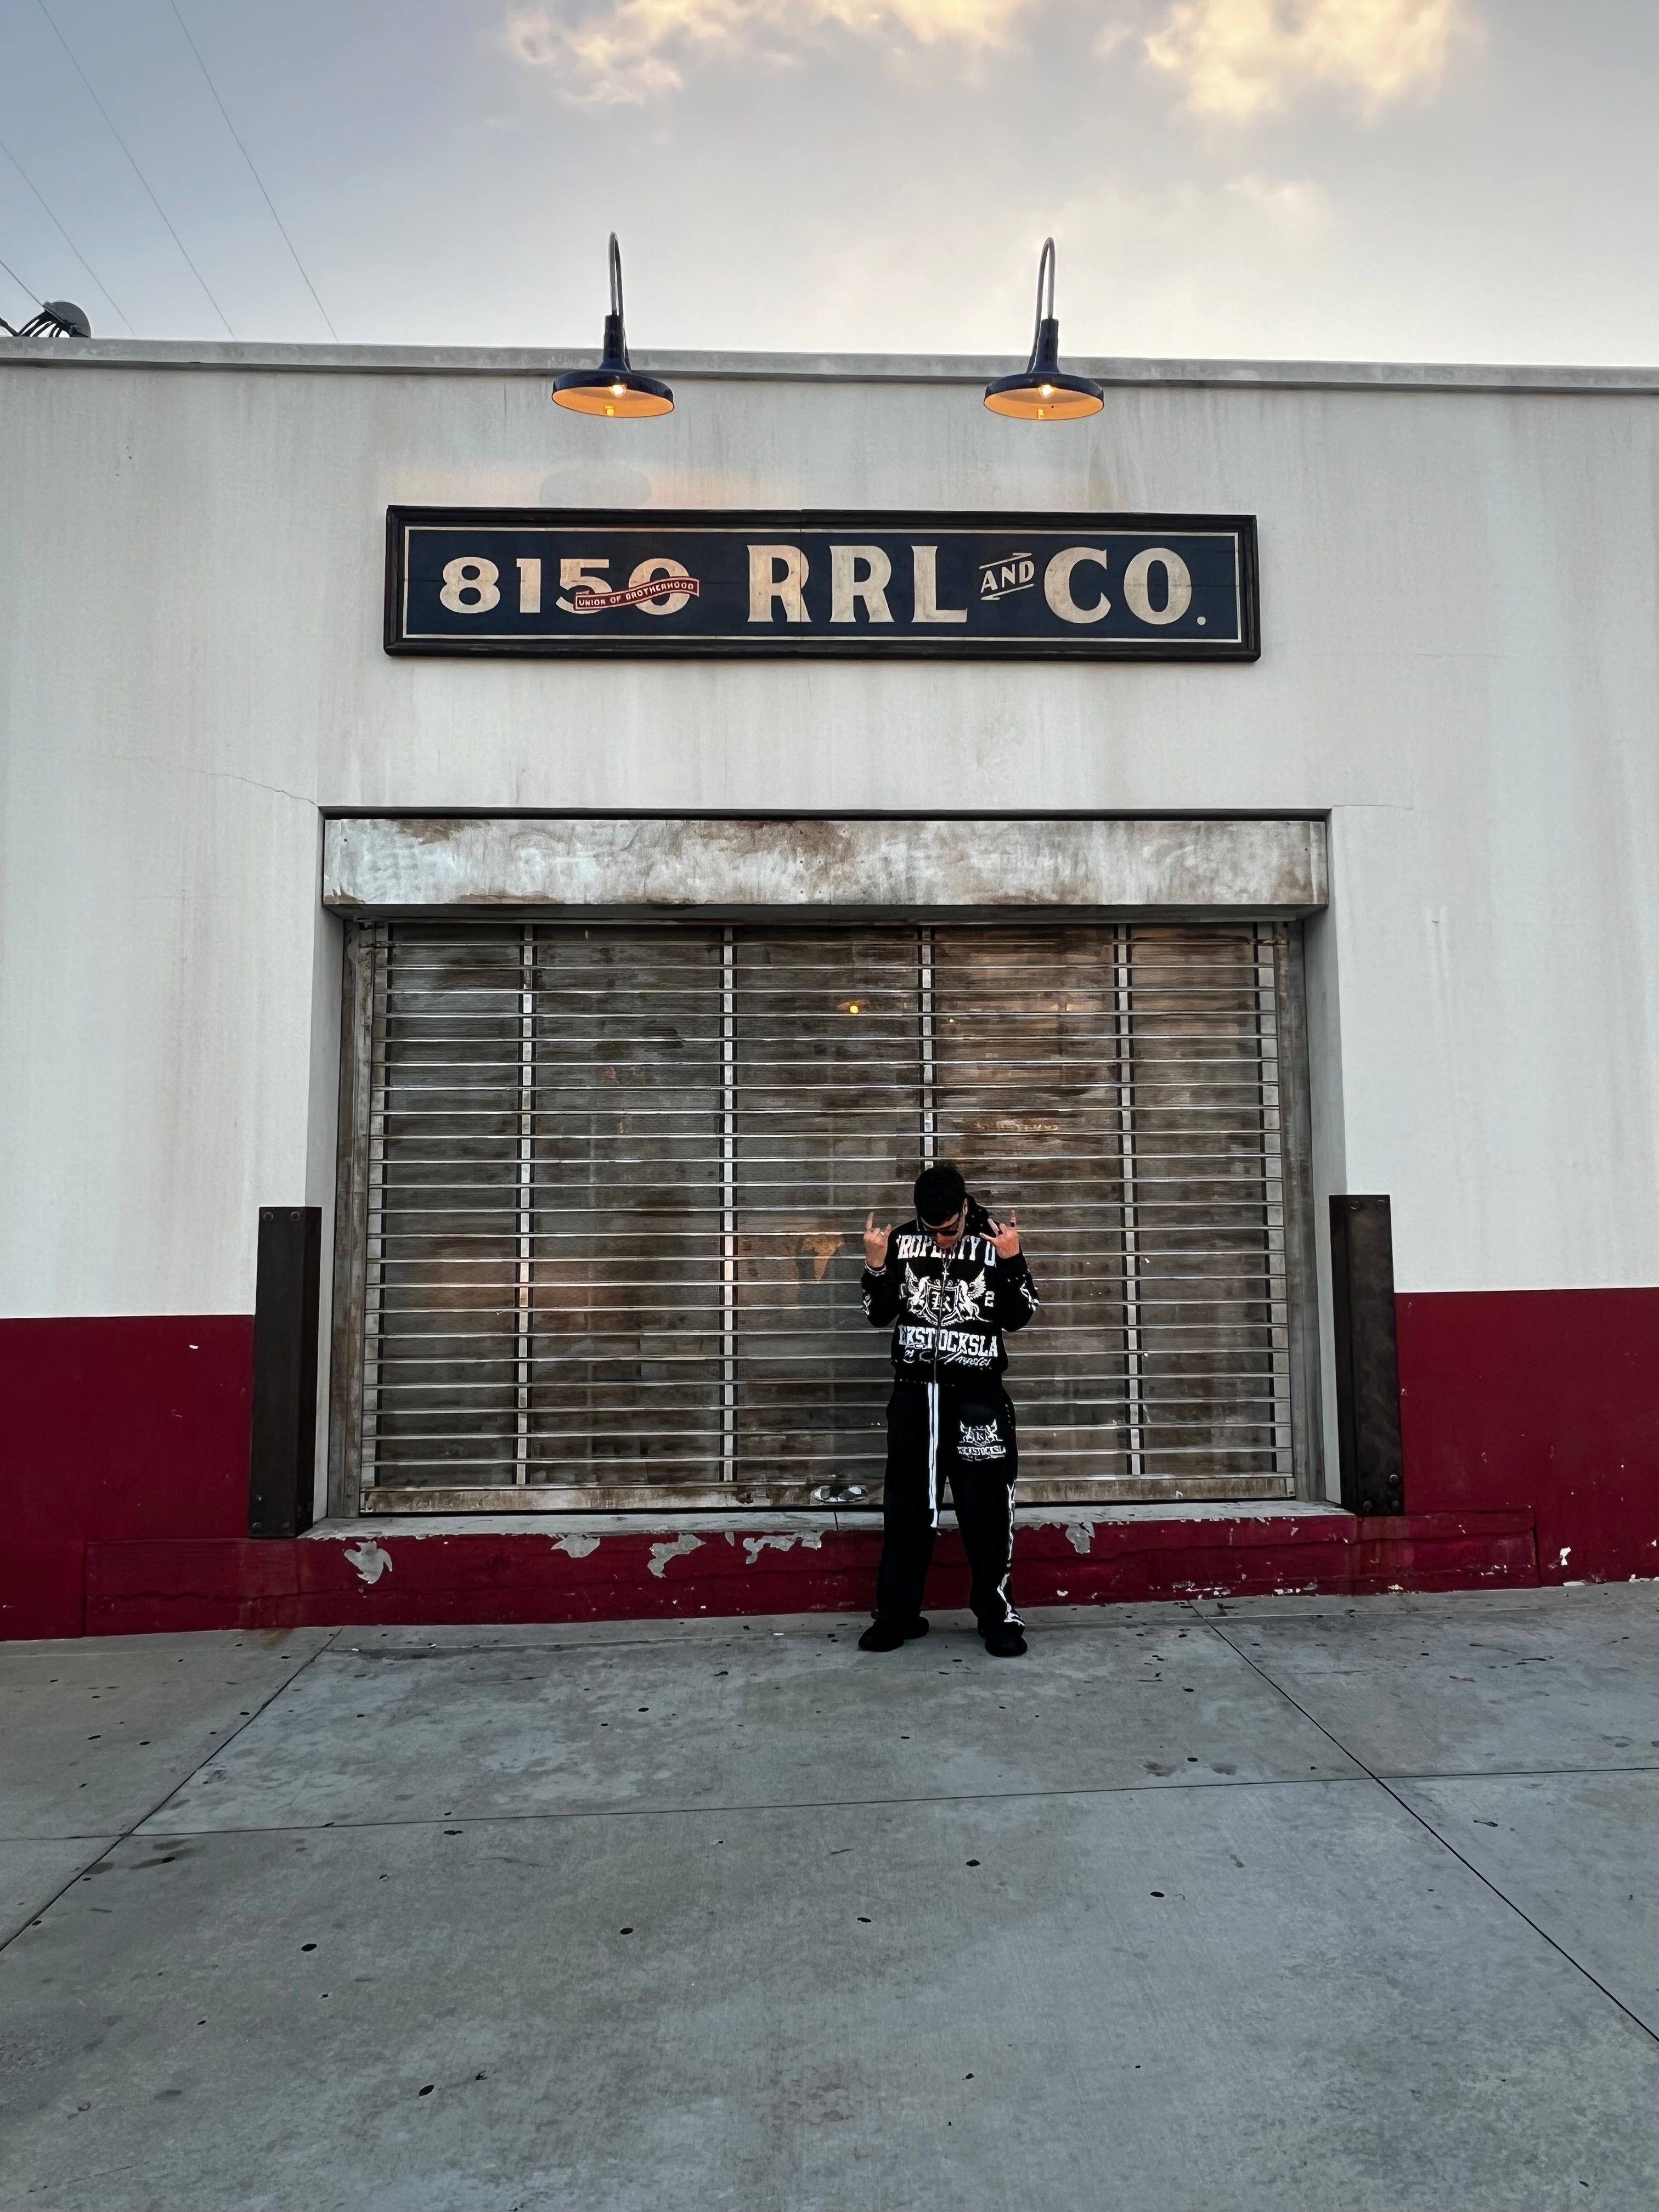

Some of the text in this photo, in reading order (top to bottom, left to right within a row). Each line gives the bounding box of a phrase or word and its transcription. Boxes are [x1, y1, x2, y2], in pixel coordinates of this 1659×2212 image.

[439, 545, 1207, 625] 8150 RRL AND CO.
[610, 595, 622, 603] OF
[625, 582, 694, 600] BROTHERHOOD
